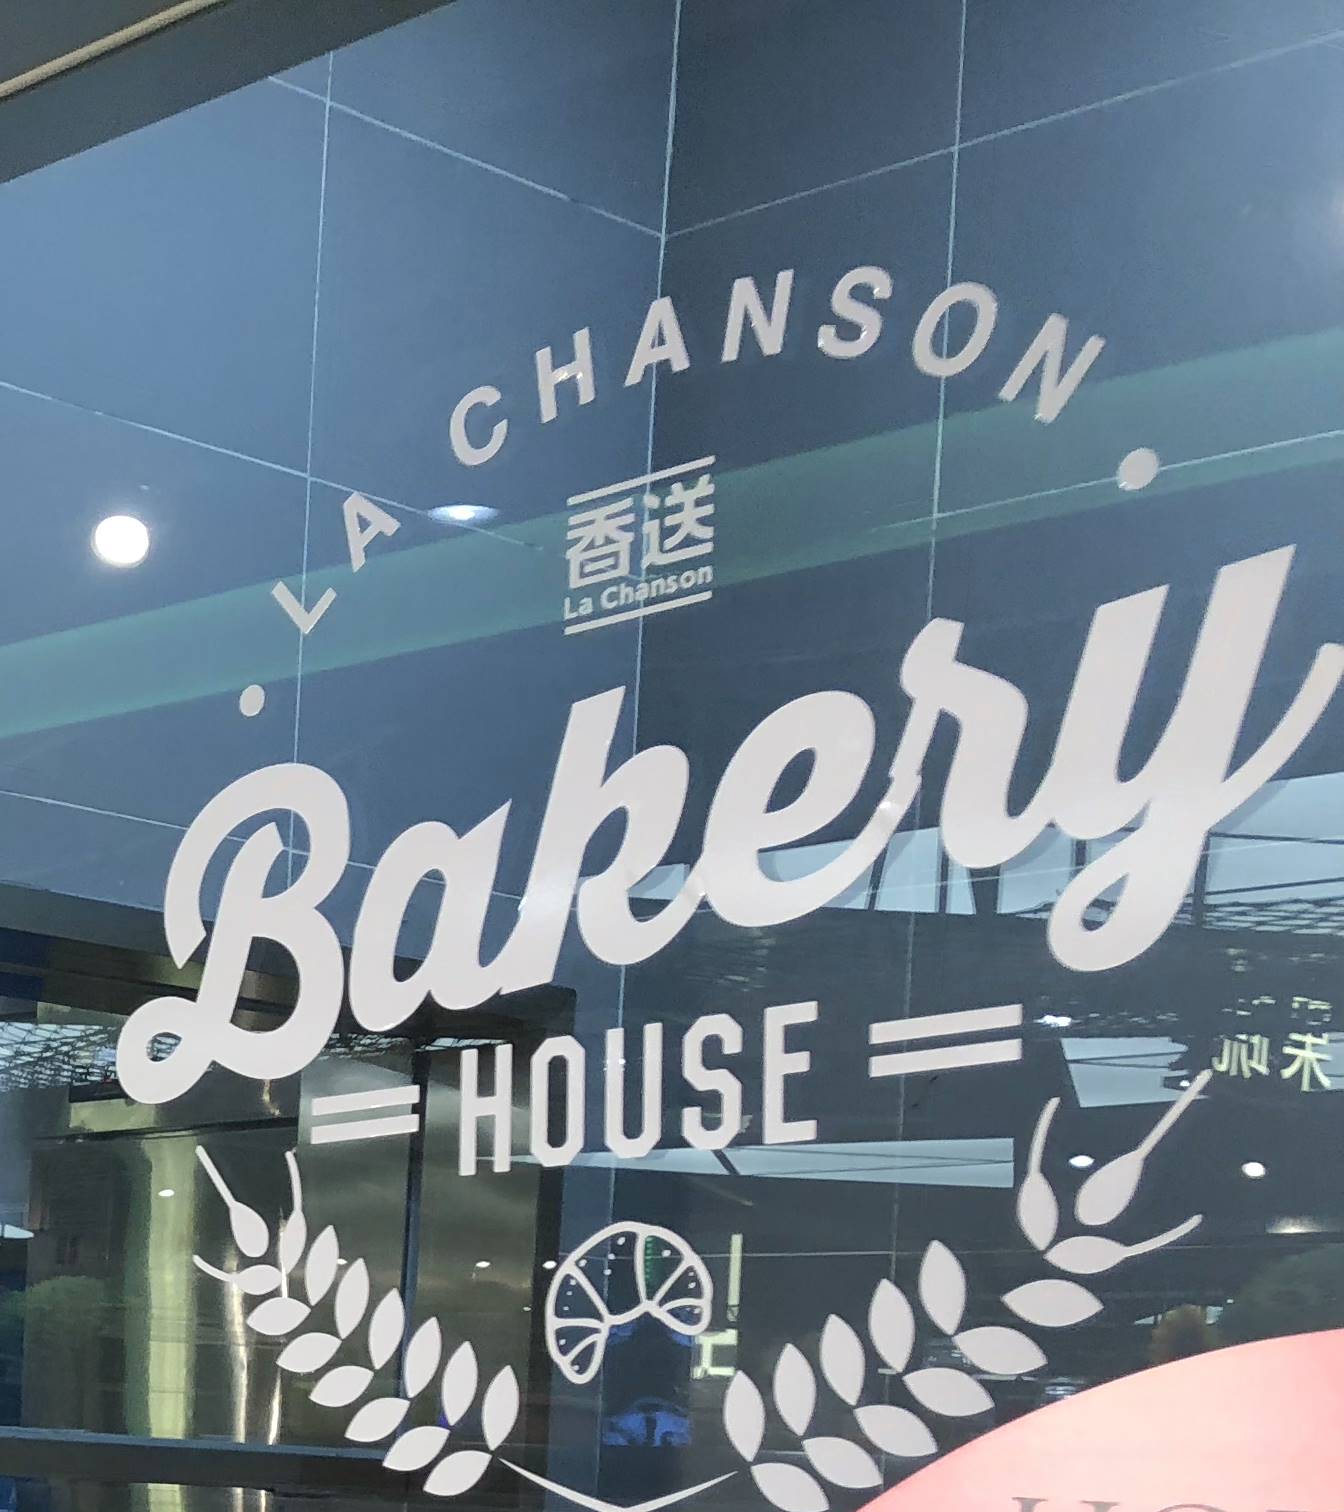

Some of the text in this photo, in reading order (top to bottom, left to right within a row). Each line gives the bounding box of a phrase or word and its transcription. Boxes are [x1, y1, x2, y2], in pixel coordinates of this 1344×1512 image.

[272, 265, 1107, 634] LA CHANSON
[566, 473, 715, 589] 香送
[564, 565, 713, 620] La Chanson
[115, 543, 1344, 1104] Bakery
[458, 1000, 819, 1177] HOUSE
